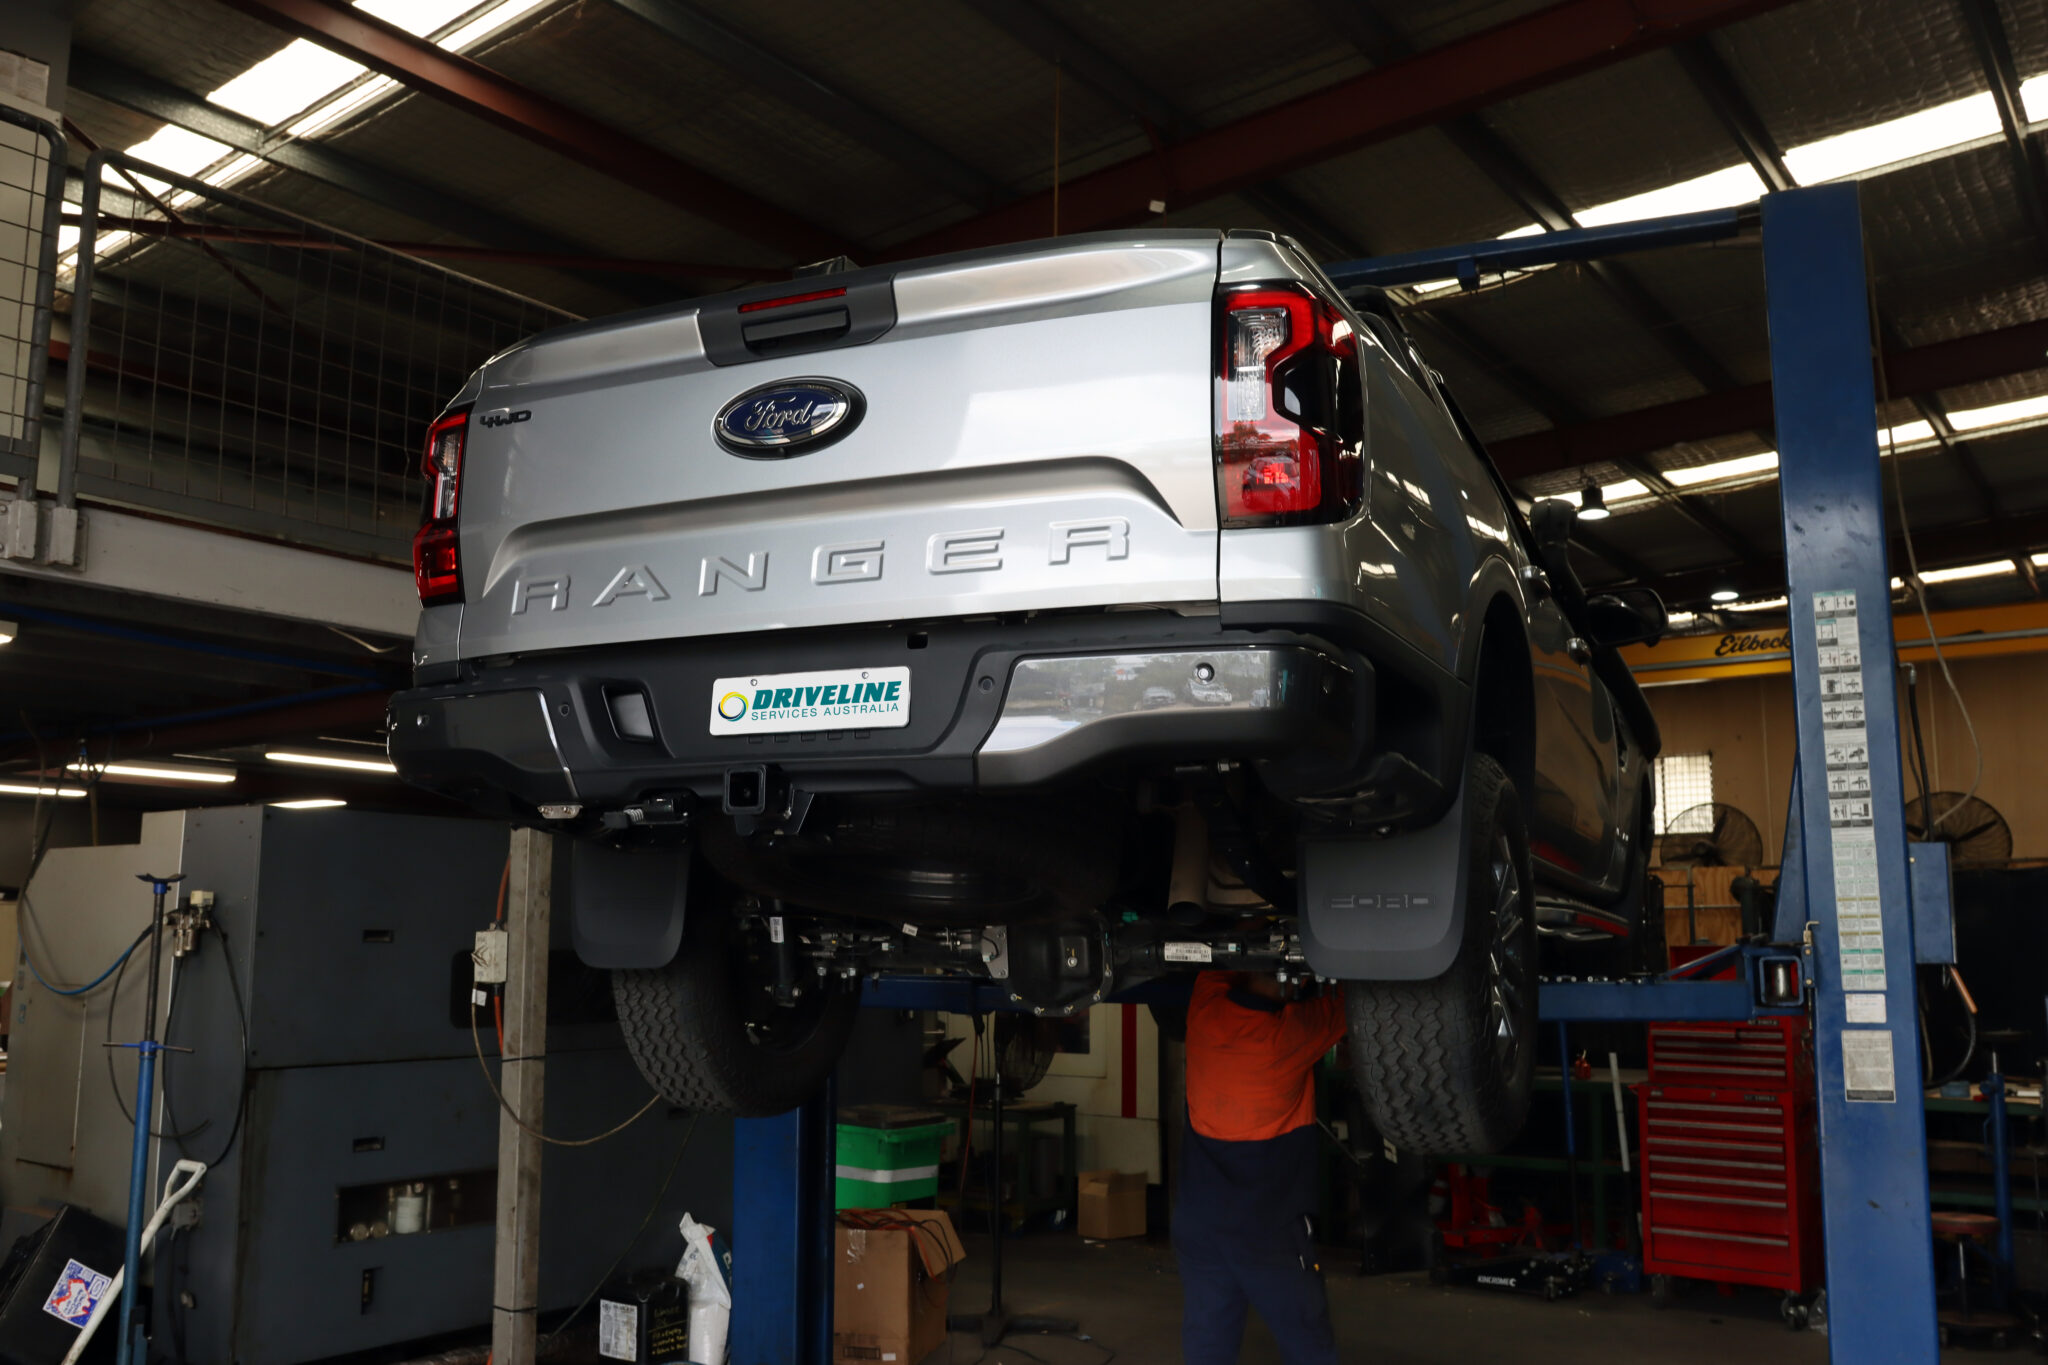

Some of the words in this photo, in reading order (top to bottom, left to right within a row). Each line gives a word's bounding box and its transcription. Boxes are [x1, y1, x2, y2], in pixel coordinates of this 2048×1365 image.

[480, 410, 532, 428] 4WD
[744, 396, 813, 431] Ford
[511, 516, 1130, 615] RANGER
[1715, 631, 1790, 657] Eilbeck
[752, 680, 902, 710] DRIVELINE
[751, 707, 818, 721] SERVICES
[823, 702, 900, 716] AUSTRALIA
